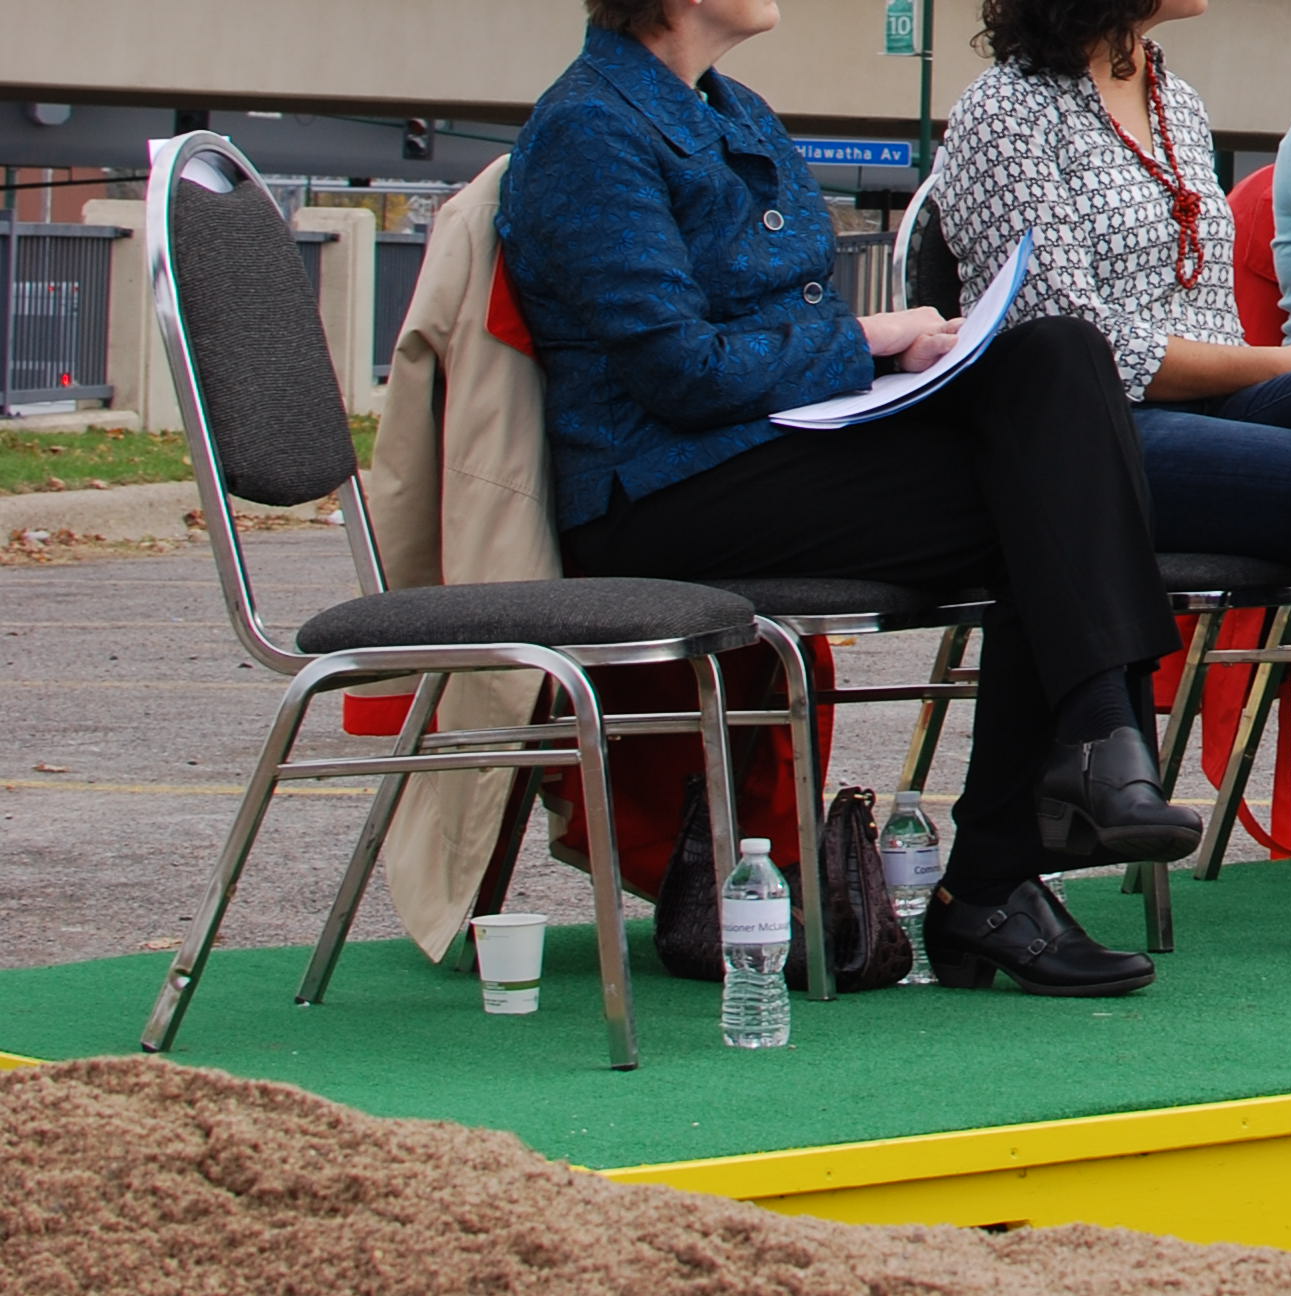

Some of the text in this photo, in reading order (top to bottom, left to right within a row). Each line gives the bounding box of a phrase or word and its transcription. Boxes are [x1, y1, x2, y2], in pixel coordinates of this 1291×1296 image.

[889, 16, 911, 35] 10
[796, 145, 901, 161] Hiawatha Av
